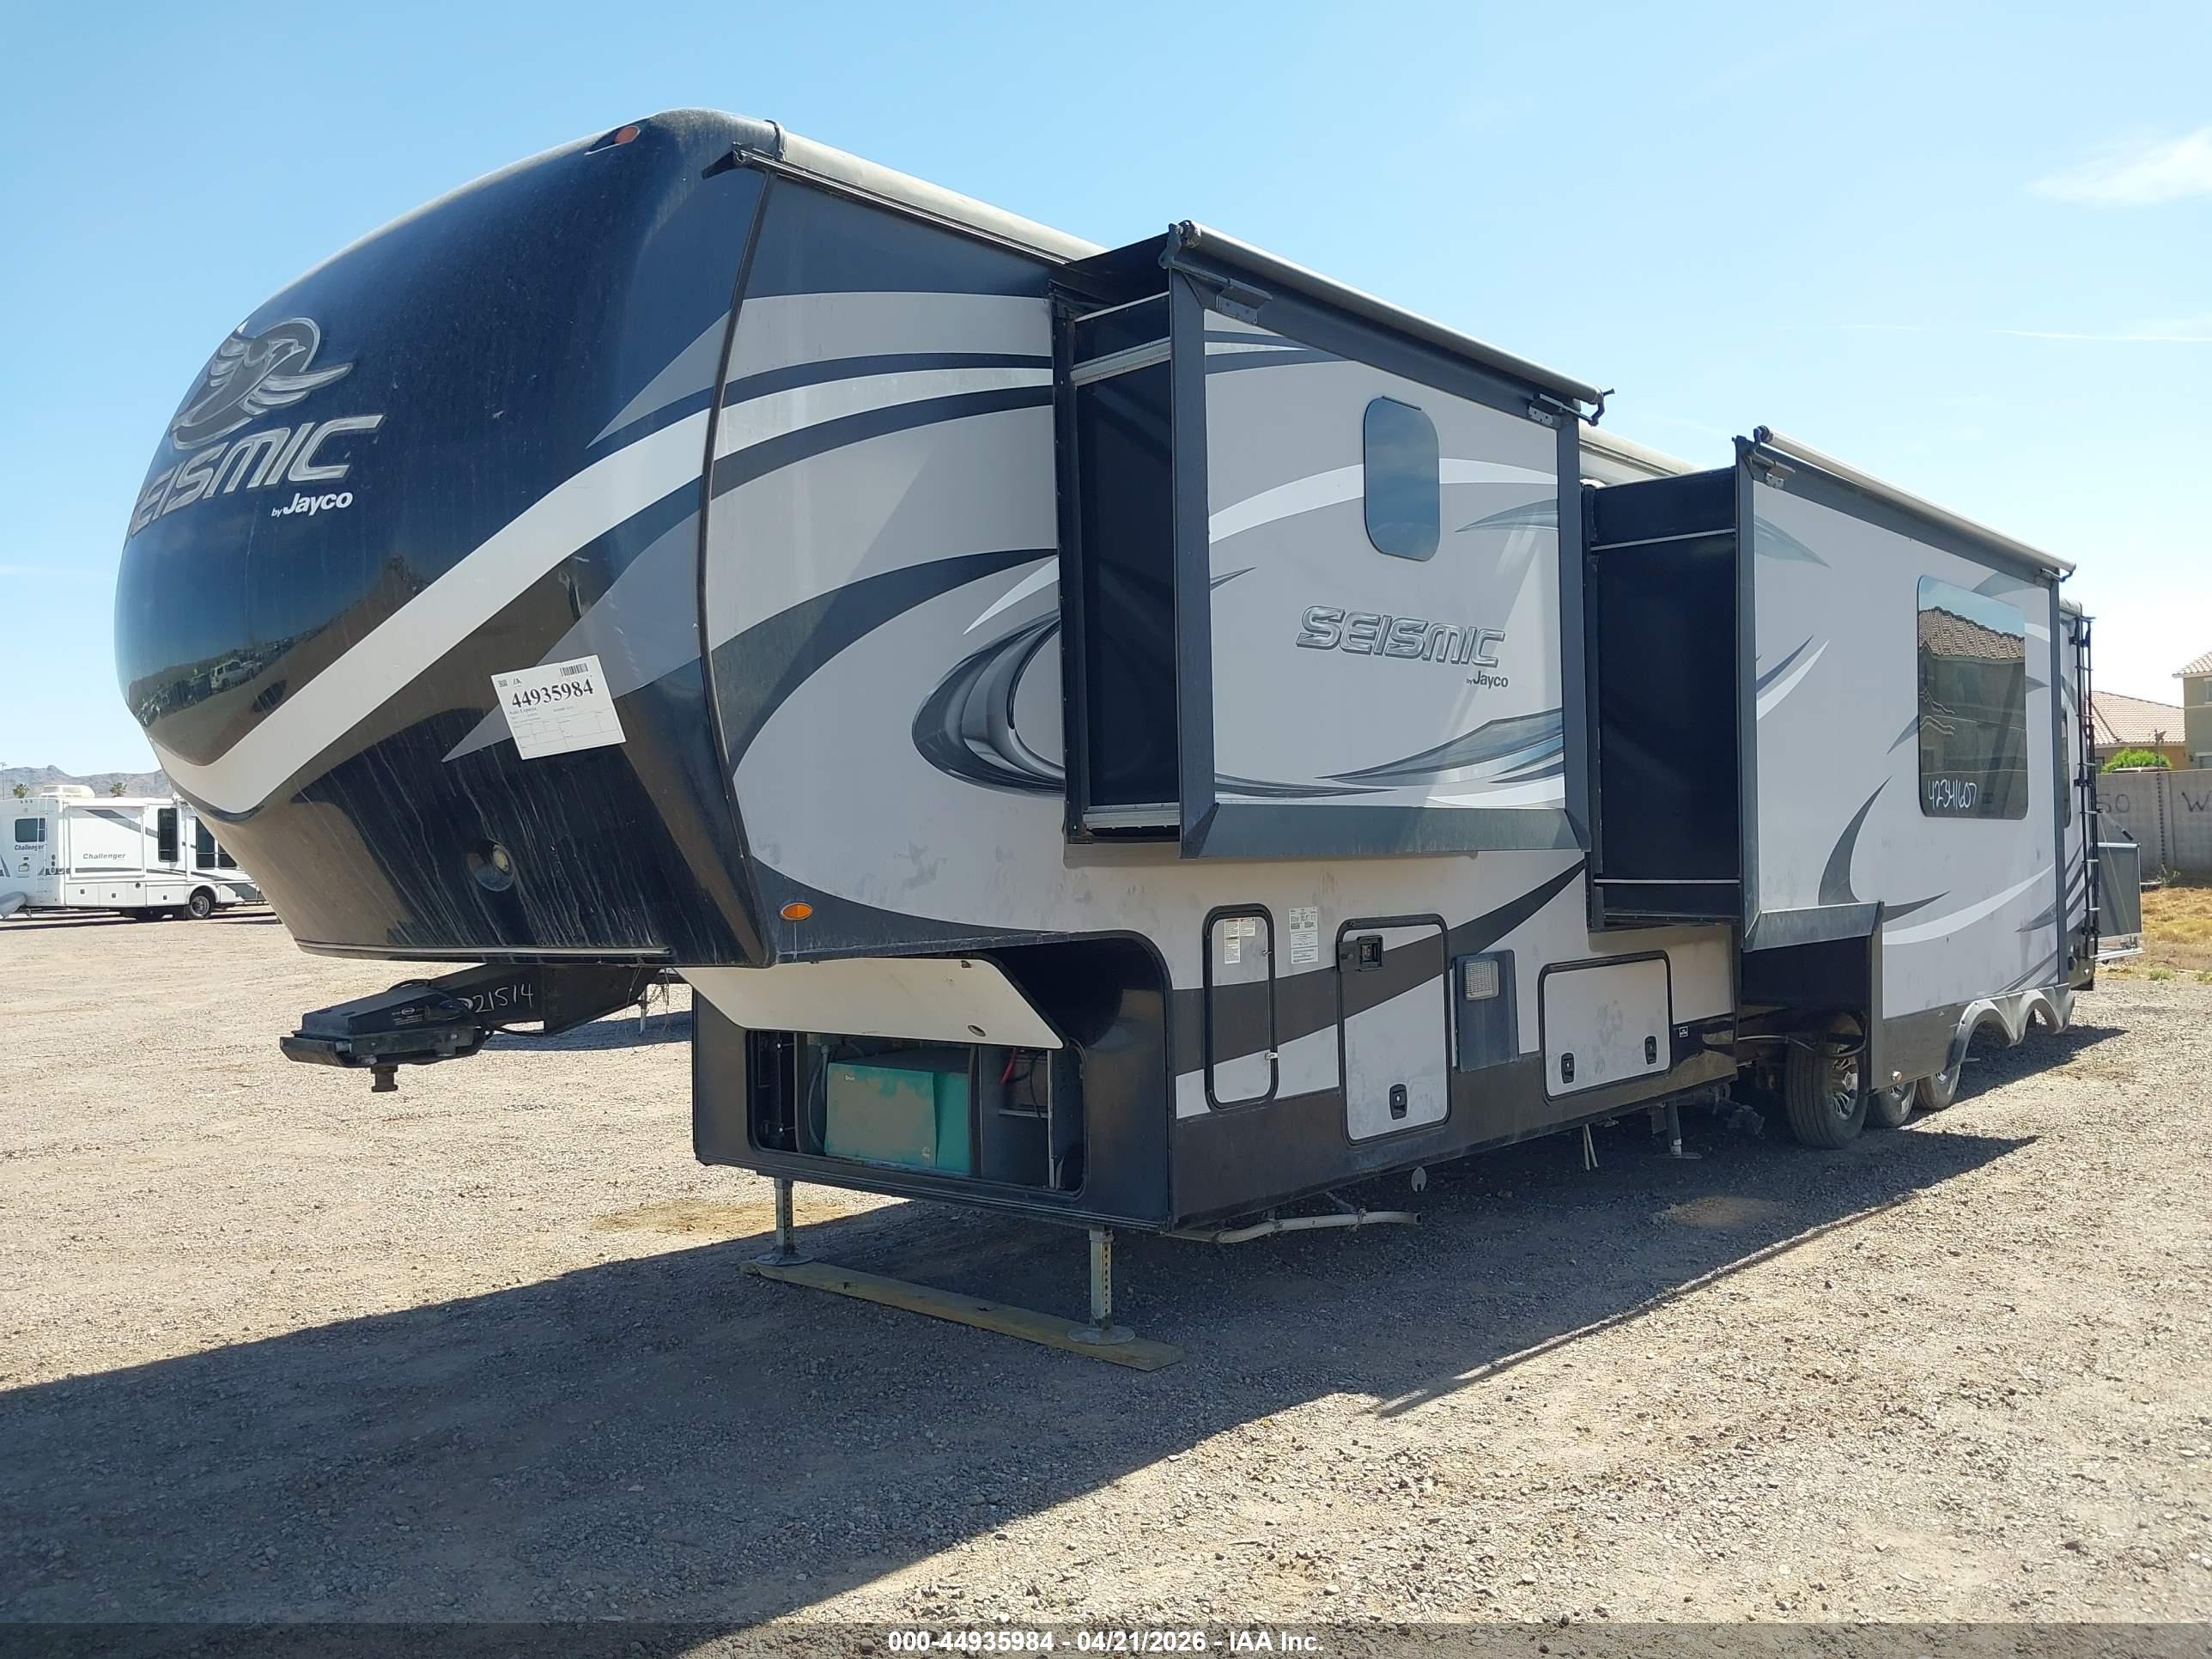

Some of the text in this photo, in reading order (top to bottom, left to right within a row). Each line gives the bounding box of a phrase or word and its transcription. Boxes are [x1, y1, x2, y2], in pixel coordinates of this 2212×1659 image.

[126, 413, 386, 537] EISMIC
[271, 492, 353, 517] by Jayco
[1296, 605, 1505, 668] SEISMIC
[512, 678, 594, 708] 44935984
[1473, 670, 1509, 690] Jayco
